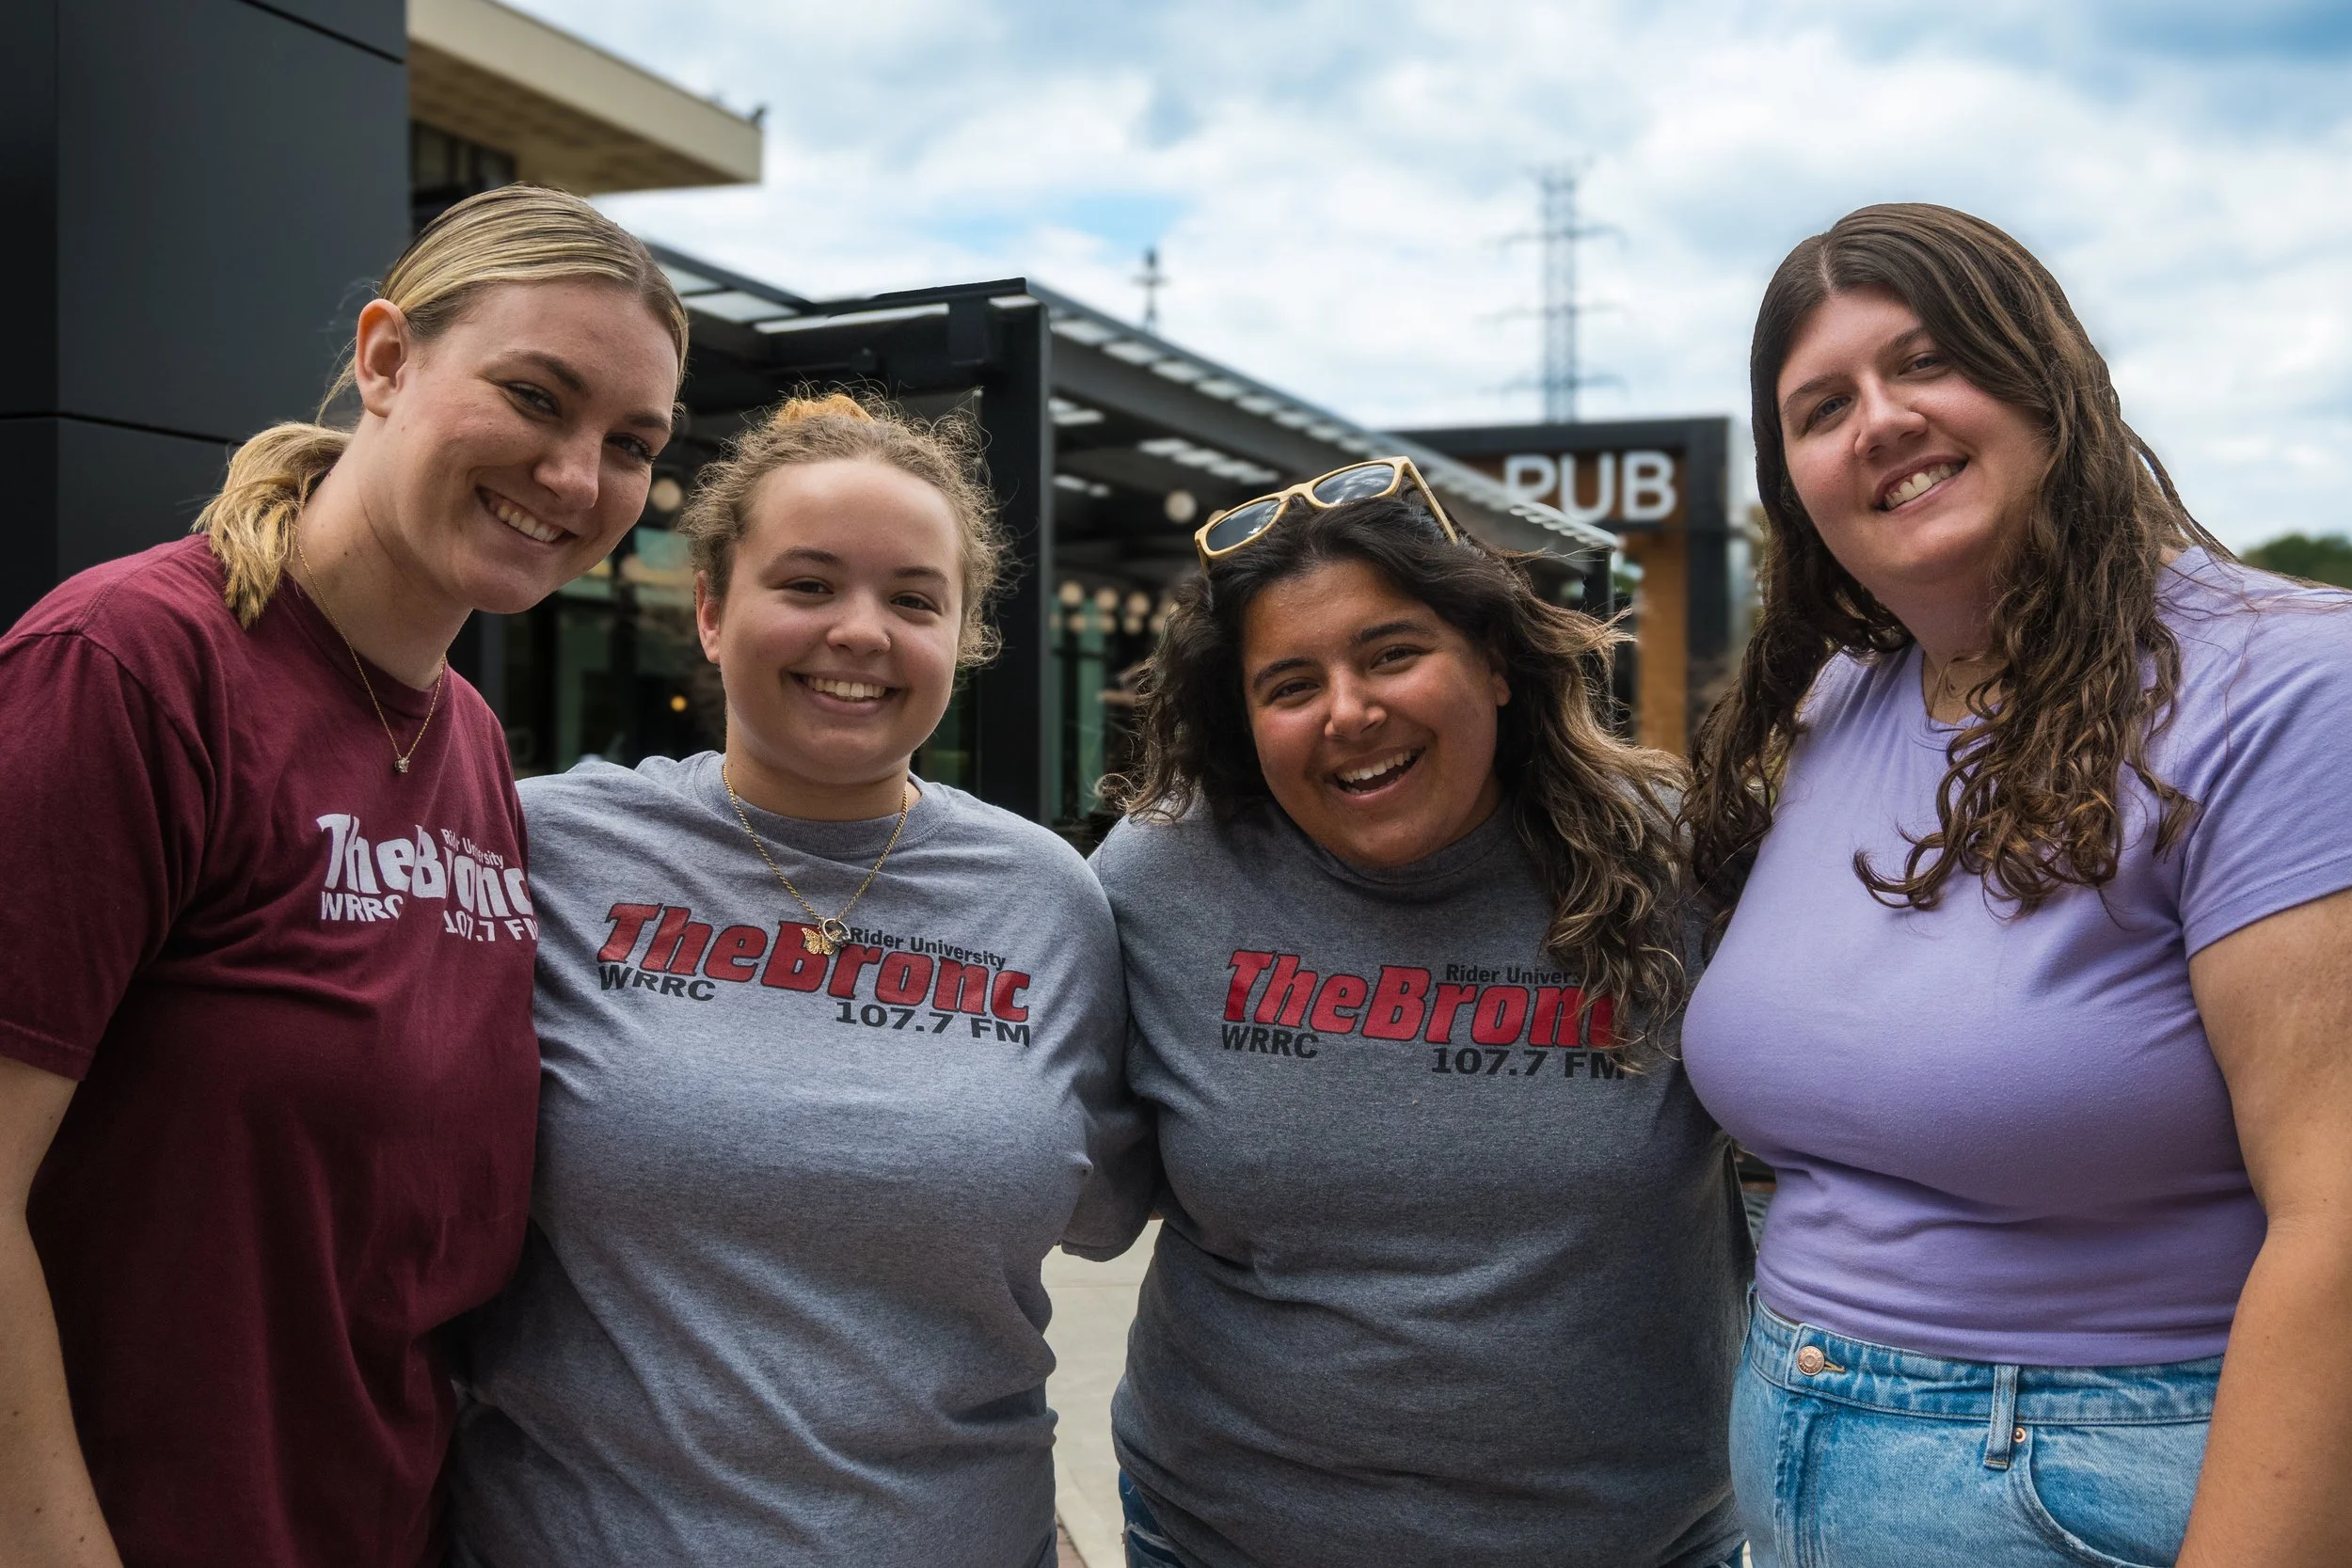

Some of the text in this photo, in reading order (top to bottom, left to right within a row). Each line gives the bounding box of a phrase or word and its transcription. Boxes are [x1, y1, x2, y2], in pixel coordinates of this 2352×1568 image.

[1505, 451, 1677, 524] PUB
[321, 892, 404, 922] WRRC
[443, 911, 496, 942] 107.7
[596, 902, 1031, 1022] TheBronc
[850, 927, 1007, 971] Rider University
[598, 964, 716, 1002] WRRC
[1446, 963, 1578, 985] Rider Univer
[836, 1002, 1031, 1048] 107.7 FM
[1221, 1024, 1319, 1059] WRRC
[1431, 1048, 1626, 1080] 107.7 FM
